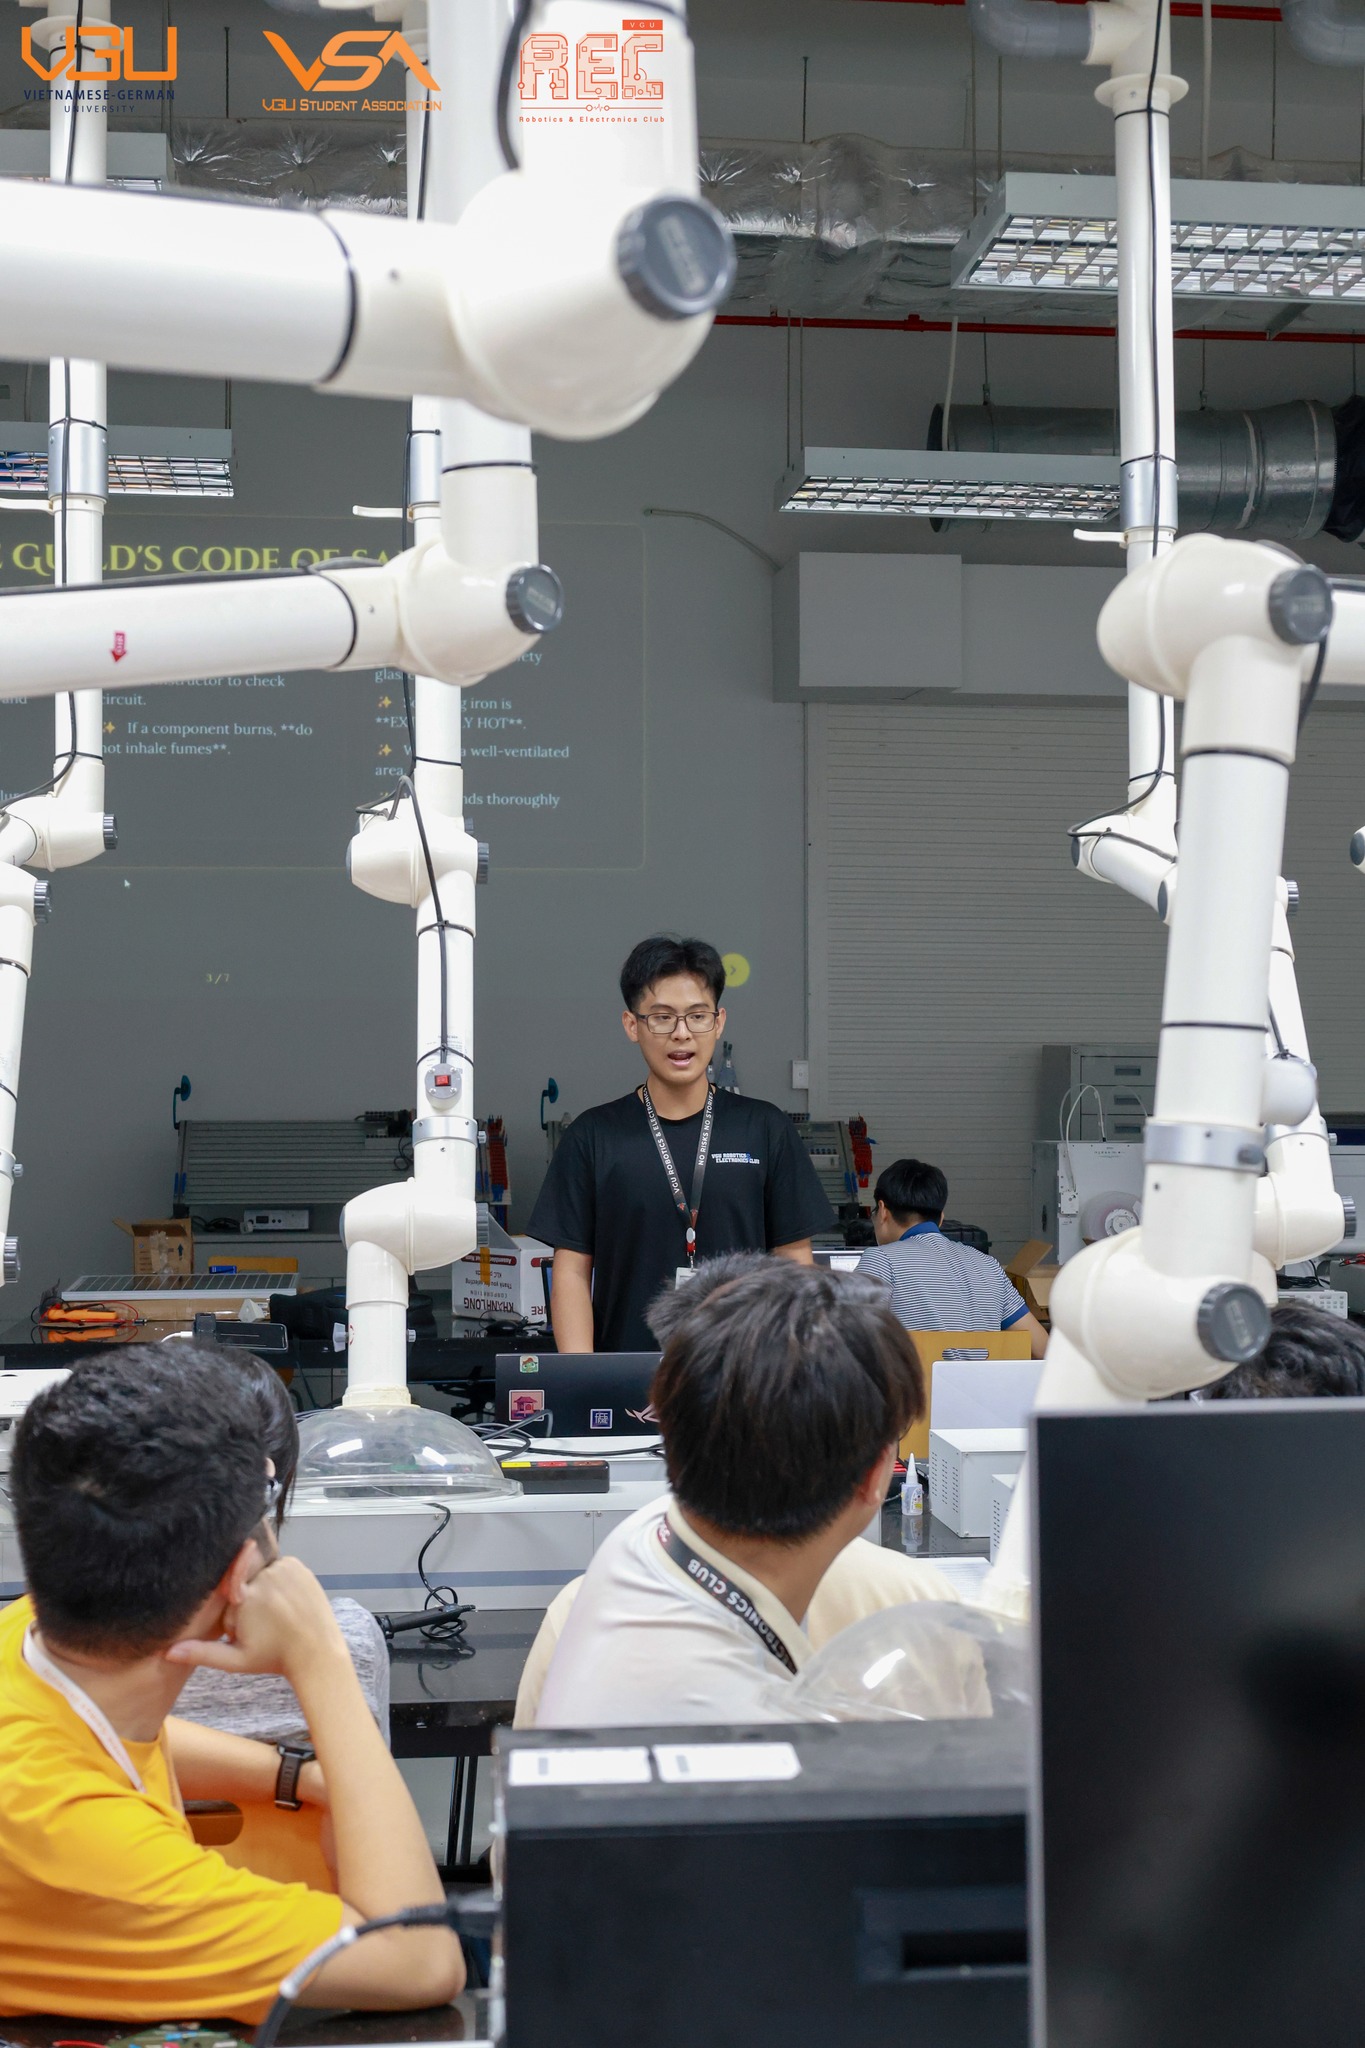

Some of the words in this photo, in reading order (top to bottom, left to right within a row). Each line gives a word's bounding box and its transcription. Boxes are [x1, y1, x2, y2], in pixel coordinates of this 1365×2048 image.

[12, 543, 163, 577] GUD'S
[172, 545, 280, 573] CODE
[227, 676, 242, 687] to
[245, 674, 286, 687] check
[470, 697, 498, 710] iron
[501, 698, 513, 710] is
[127, 721, 139, 734] If
[140, 724, 149, 734] a
[152, 722, 230, 738] component
[233, 722, 277, 737] burns,
[126, 742, 167, 755] inhale
[470, 744, 570, 758] well-ventilated
[487, 793, 561, 808] thoroughly
[643, 1087, 659, 1131] ELECTRONICS
[704, 1120, 711, 1131] NO
[700, 1132, 709, 1153] RISKS
[657, 1138, 675, 1176] ROBOTICS
[698, 1155, 706, 1166] NO
[670, 1176, 681, 1194] VGU
[687, 1558, 727, 1595] CLUB
